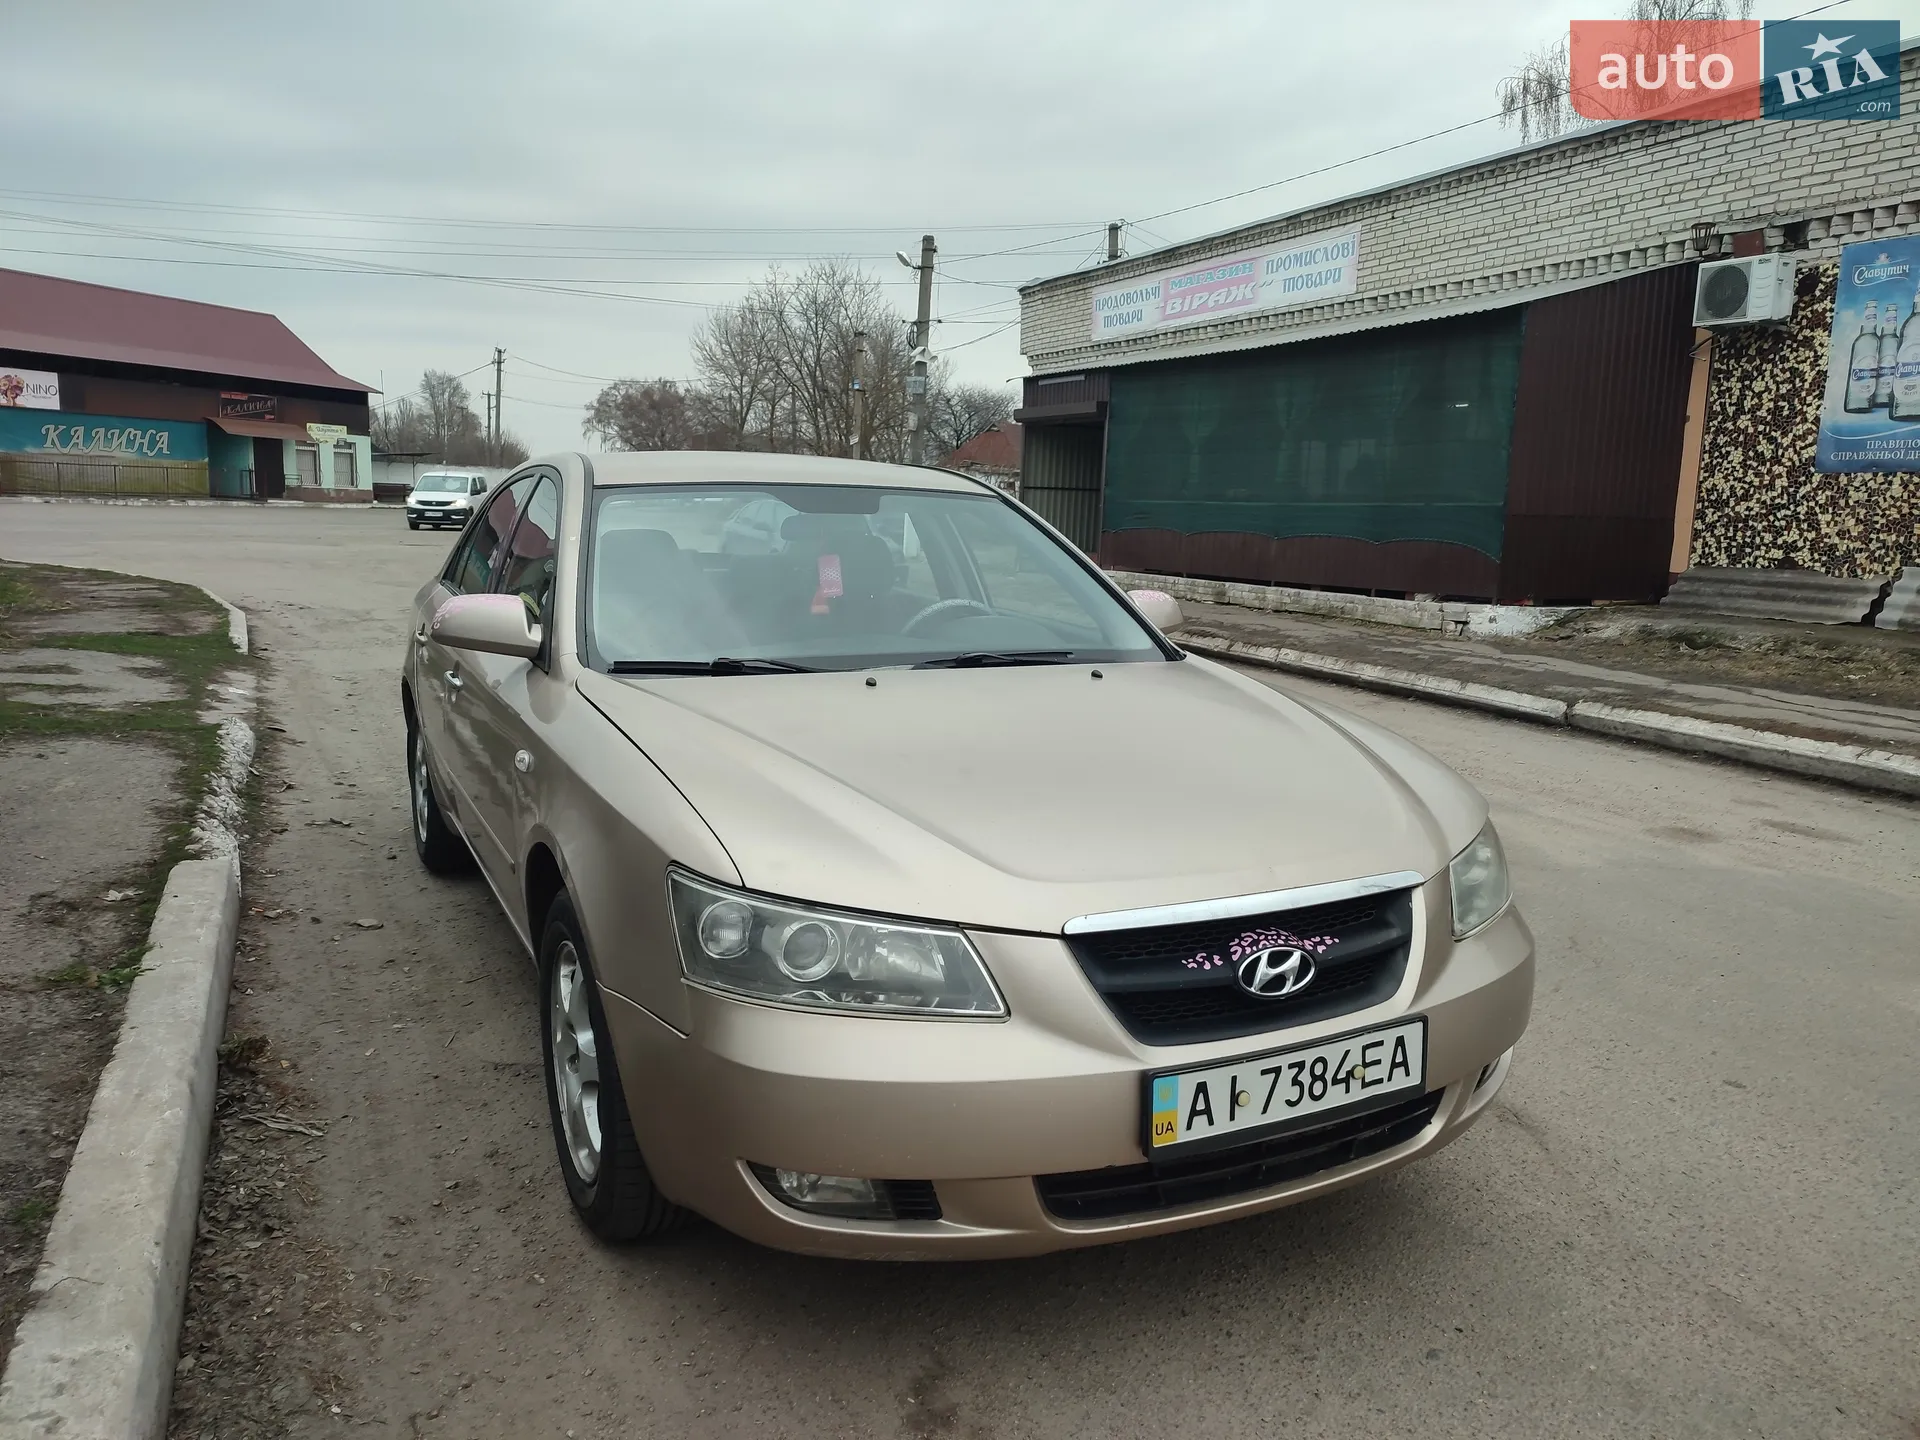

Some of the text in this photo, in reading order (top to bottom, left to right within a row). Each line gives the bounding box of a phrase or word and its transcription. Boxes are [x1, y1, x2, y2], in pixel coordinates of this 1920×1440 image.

[1266, 235, 1356, 275] ПРОМИСЛОВІ
[1169, 262, 1255, 291] МАГАЗИН
[1282, 267, 1342, 293] ТОВАРИ
[1854, 264, 1909, 284] Славутич
[1095, 280, 1160, 311] ПРОДОВОЛЬЧІ
[1103, 309, 1143, 329] ТОВАРИ
[26, 382, 58, 396] NINO
[41, 424, 170, 457] КАЛИНА
[1866, 439, 1920, 449] ПРАВИЛО
[1830, 449, 1906, 461] СПРАВЖНЬОЇ
[1155, 1120, 1175, 1136] UA
